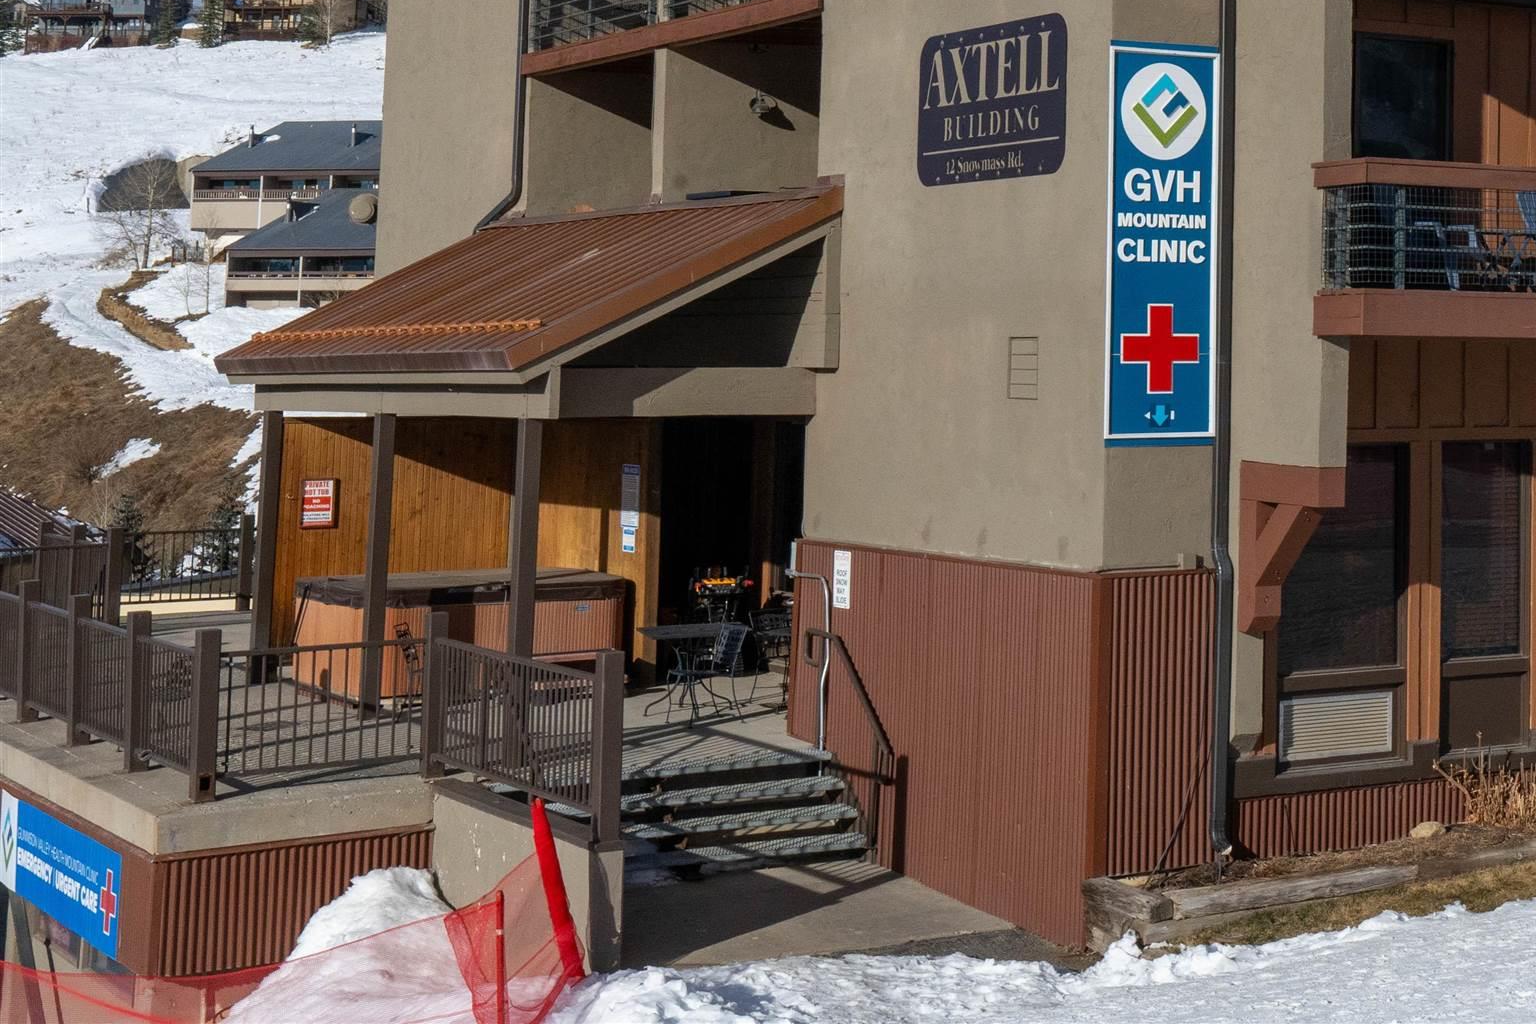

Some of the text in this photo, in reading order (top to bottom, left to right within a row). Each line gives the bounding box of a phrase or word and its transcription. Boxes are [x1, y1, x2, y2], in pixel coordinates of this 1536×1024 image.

[923, 30, 1059, 110] AXTELL
[943, 104, 1040, 142] BUILDING
[945, 149, 1025, 175] 12 Snowmass Rd.
[1123, 167, 1201, 203] GVH
[1117, 212, 1207, 229] MOUNTAIN
[1116, 237, 1206, 264] CLINIC
[55, 868, 81, 903] URGENT
[80, 884, 99, 914] CARE
